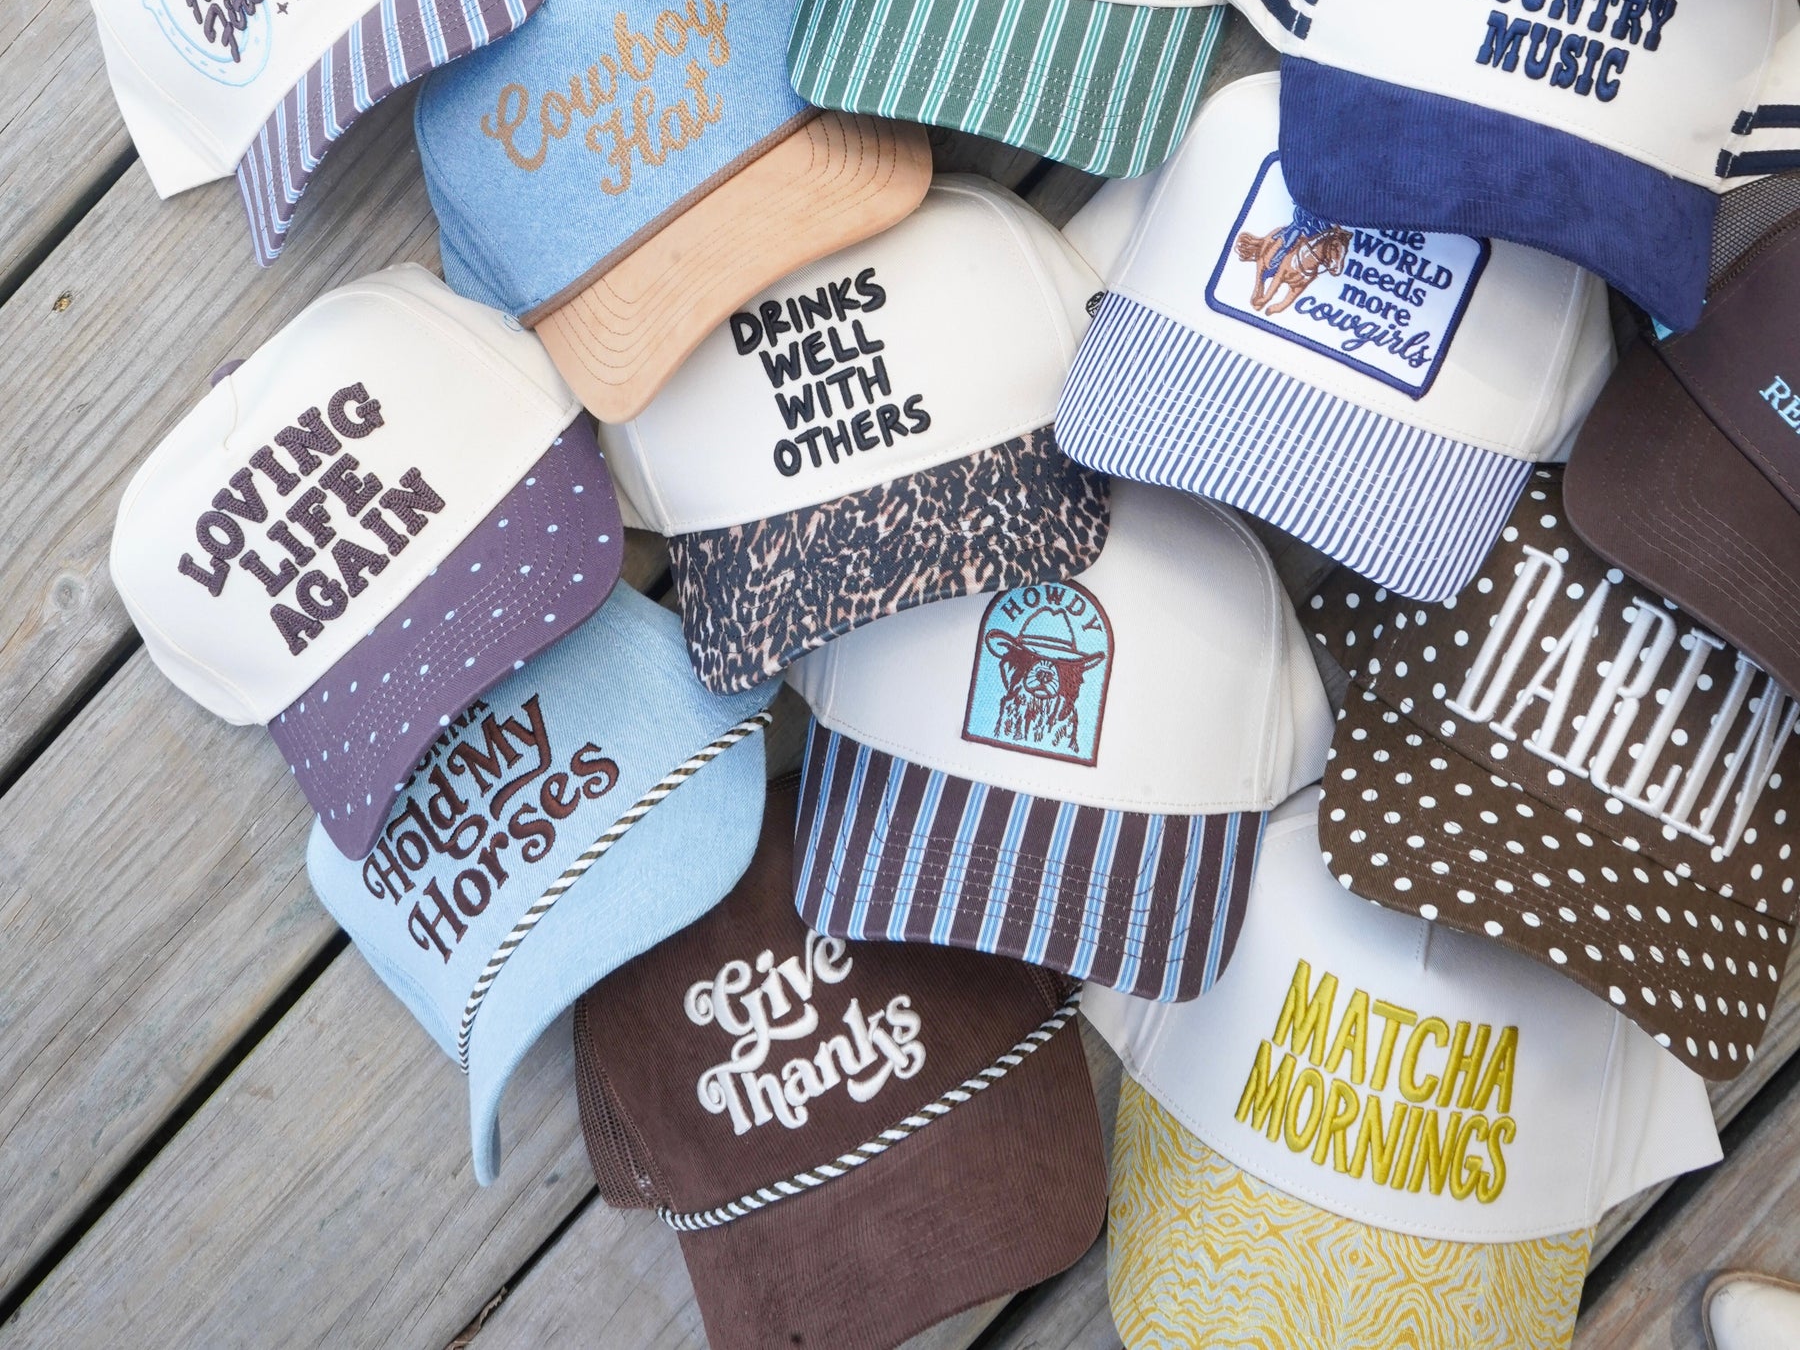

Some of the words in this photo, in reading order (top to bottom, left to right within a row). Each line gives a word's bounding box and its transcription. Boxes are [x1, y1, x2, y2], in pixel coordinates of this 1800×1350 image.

[1475, 9, 1631, 104] MUSIC
[585, 58, 725, 196] Hat
[728, 267, 886, 355] DRINKS
[1338, 283, 1411, 327] more
[1344, 258, 1427, 307] needs
[1353, 229, 1453, 290] WORLD
[758, 319, 885, 389] WELL
[1295, 296, 1432, 368] cowgirls
[773, 393, 932, 478] OTHERS
[774, 356, 892, 431] WITH
[178, 382, 385, 598] LOVING
[238, 452, 384, 598] LIFE
[269, 467, 446, 657] AGAIN
[1001, 586, 1103, 633] HOWDY
[362, 763, 488, 906] Hold
[448, 693, 552, 821] My
[408, 741, 620, 965] Horses
[684, 928, 854, 1050] Give
[1272, 958, 1519, 1114] MATCHA
[697, 994, 927, 1136] Thanks
[1234, 1038, 1517, 1205] MORNINGS
